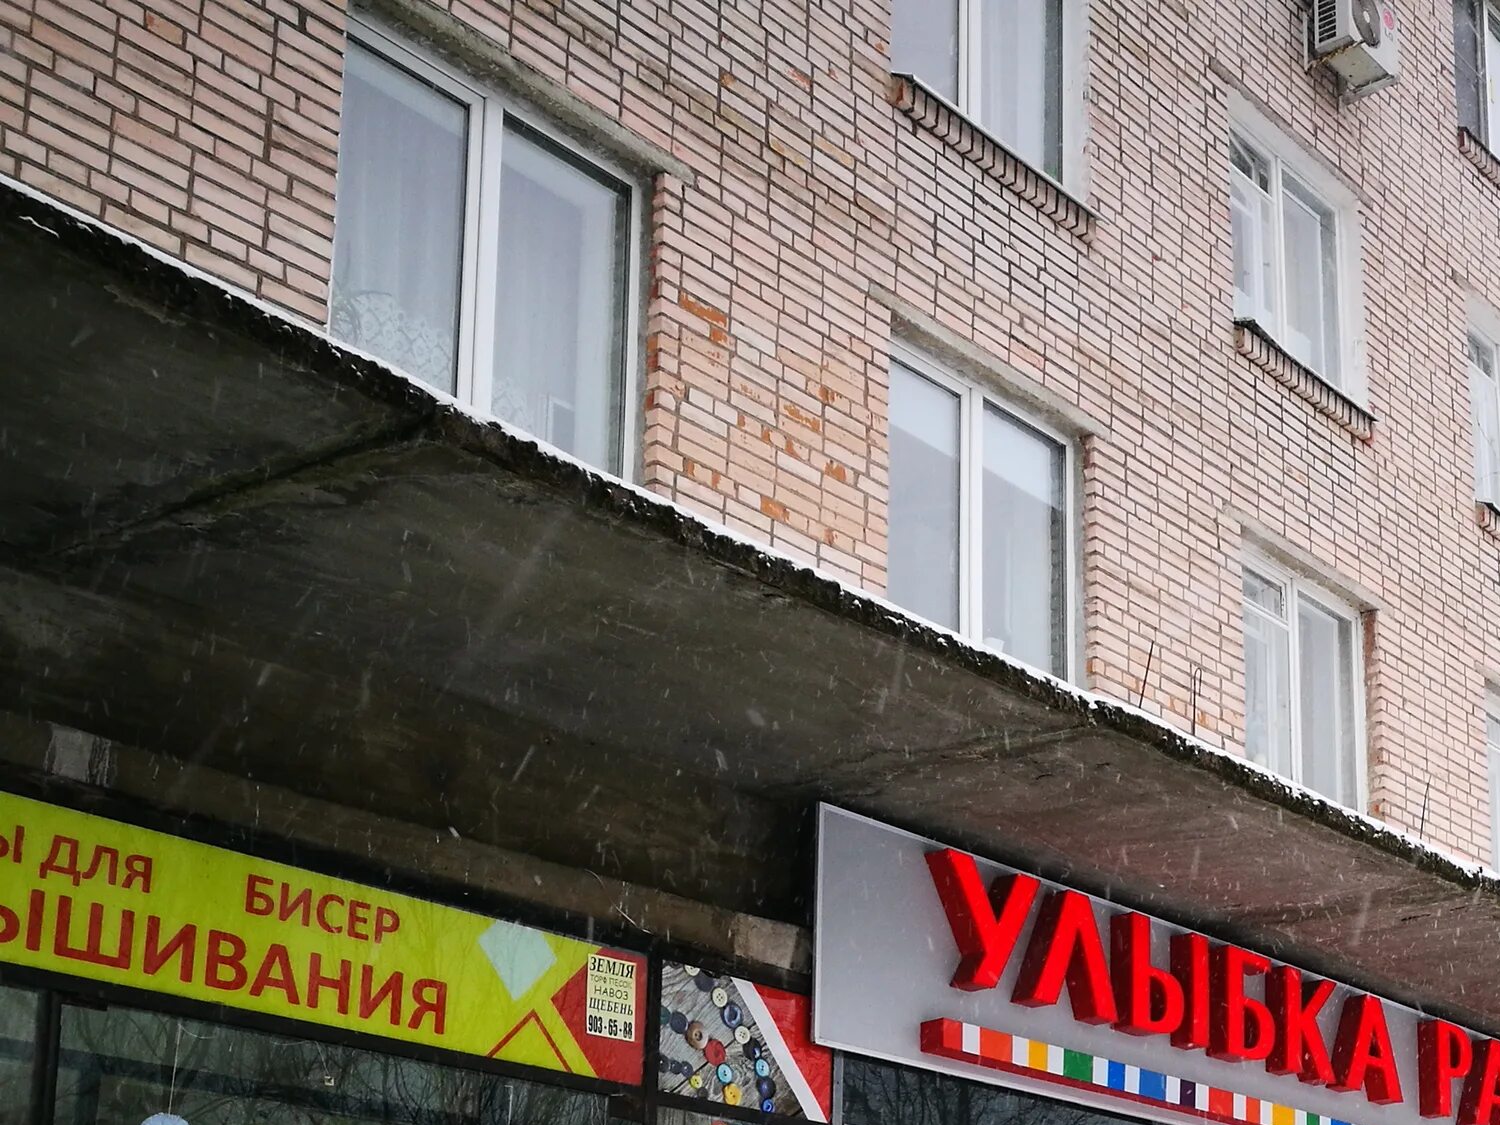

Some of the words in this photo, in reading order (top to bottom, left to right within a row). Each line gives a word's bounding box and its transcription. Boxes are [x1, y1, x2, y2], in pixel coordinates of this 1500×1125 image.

[39, 834, 154, 894] ДЛЯ
[244, 873, 400, 944] БИСЕР
[0, 888, 449, 1036] ЫШИВАНИЯ
[589, 956, 635, 979] ЗЕМЛЯ
[590, 974, 607, 984] ТОРФ
[609, 977, 633, 990] ПЕСОК
[925, 848, 1404, 1105] УЛЫБКА
[589, 997, 633, 1017] ЩЕБЕНЬ
[594, 985, 629, 1001] НАВОЗ
